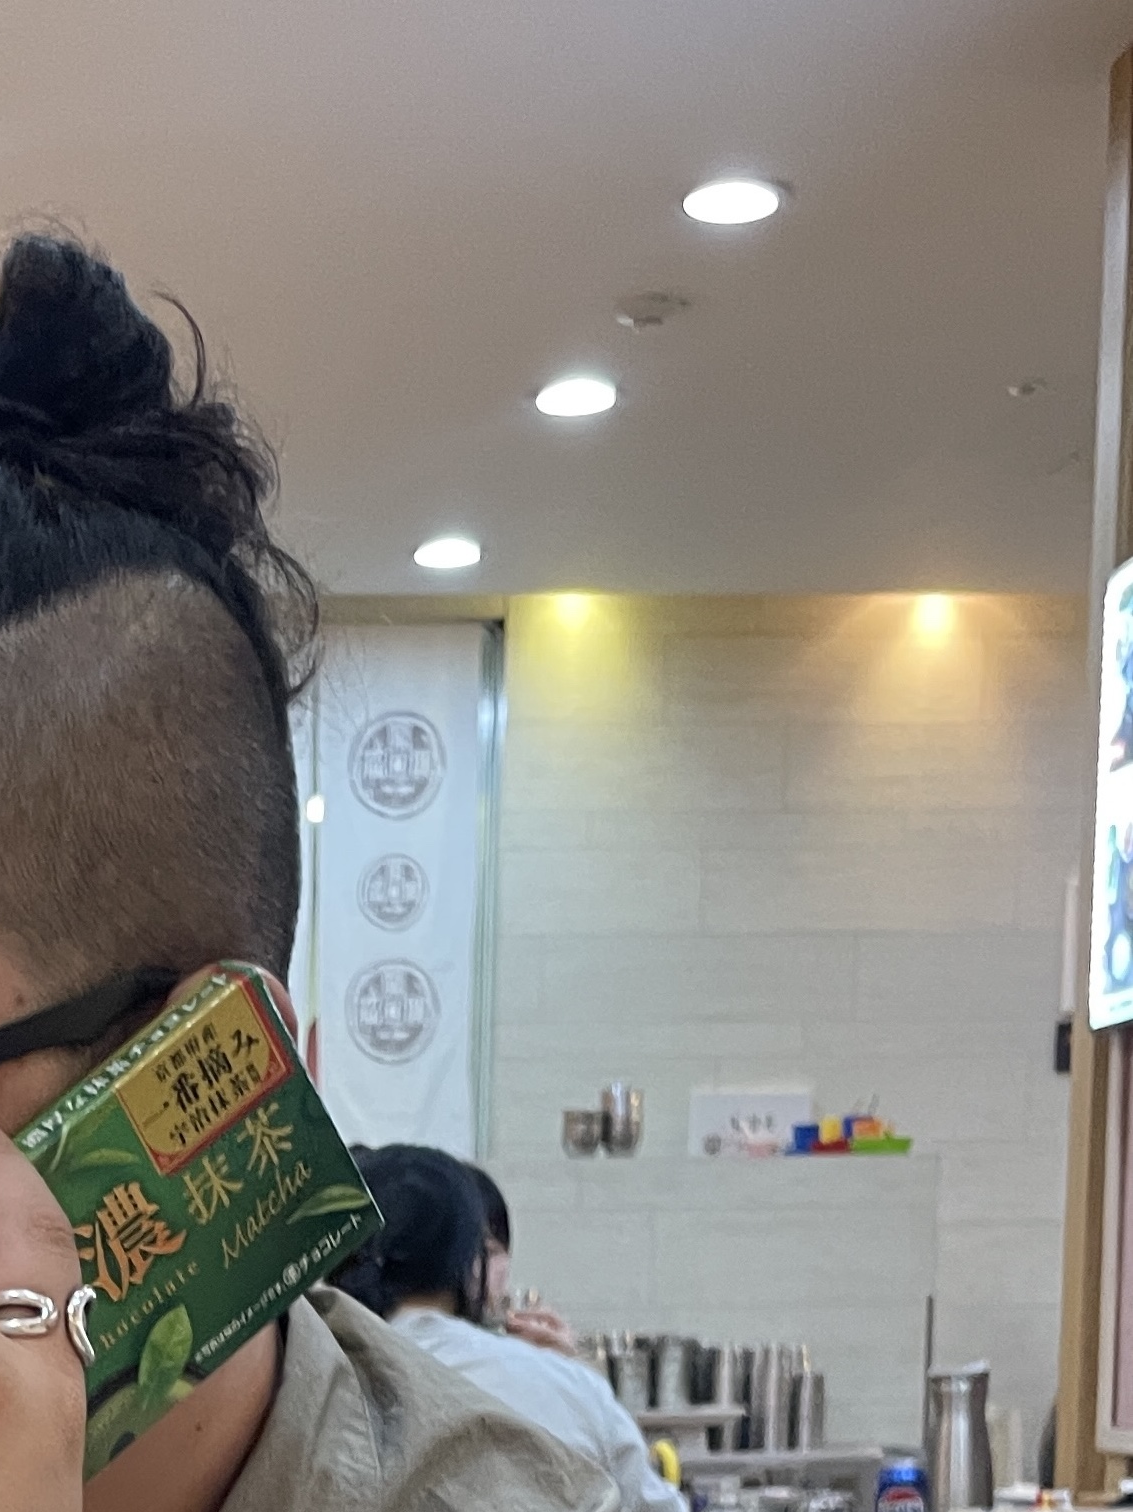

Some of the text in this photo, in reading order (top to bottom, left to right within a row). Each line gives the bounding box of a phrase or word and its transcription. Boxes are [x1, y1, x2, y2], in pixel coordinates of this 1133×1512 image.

[142, 1029, 259, 1127] 一番摘み
[100, 1160, 312, 1348] hocolate Matcha
